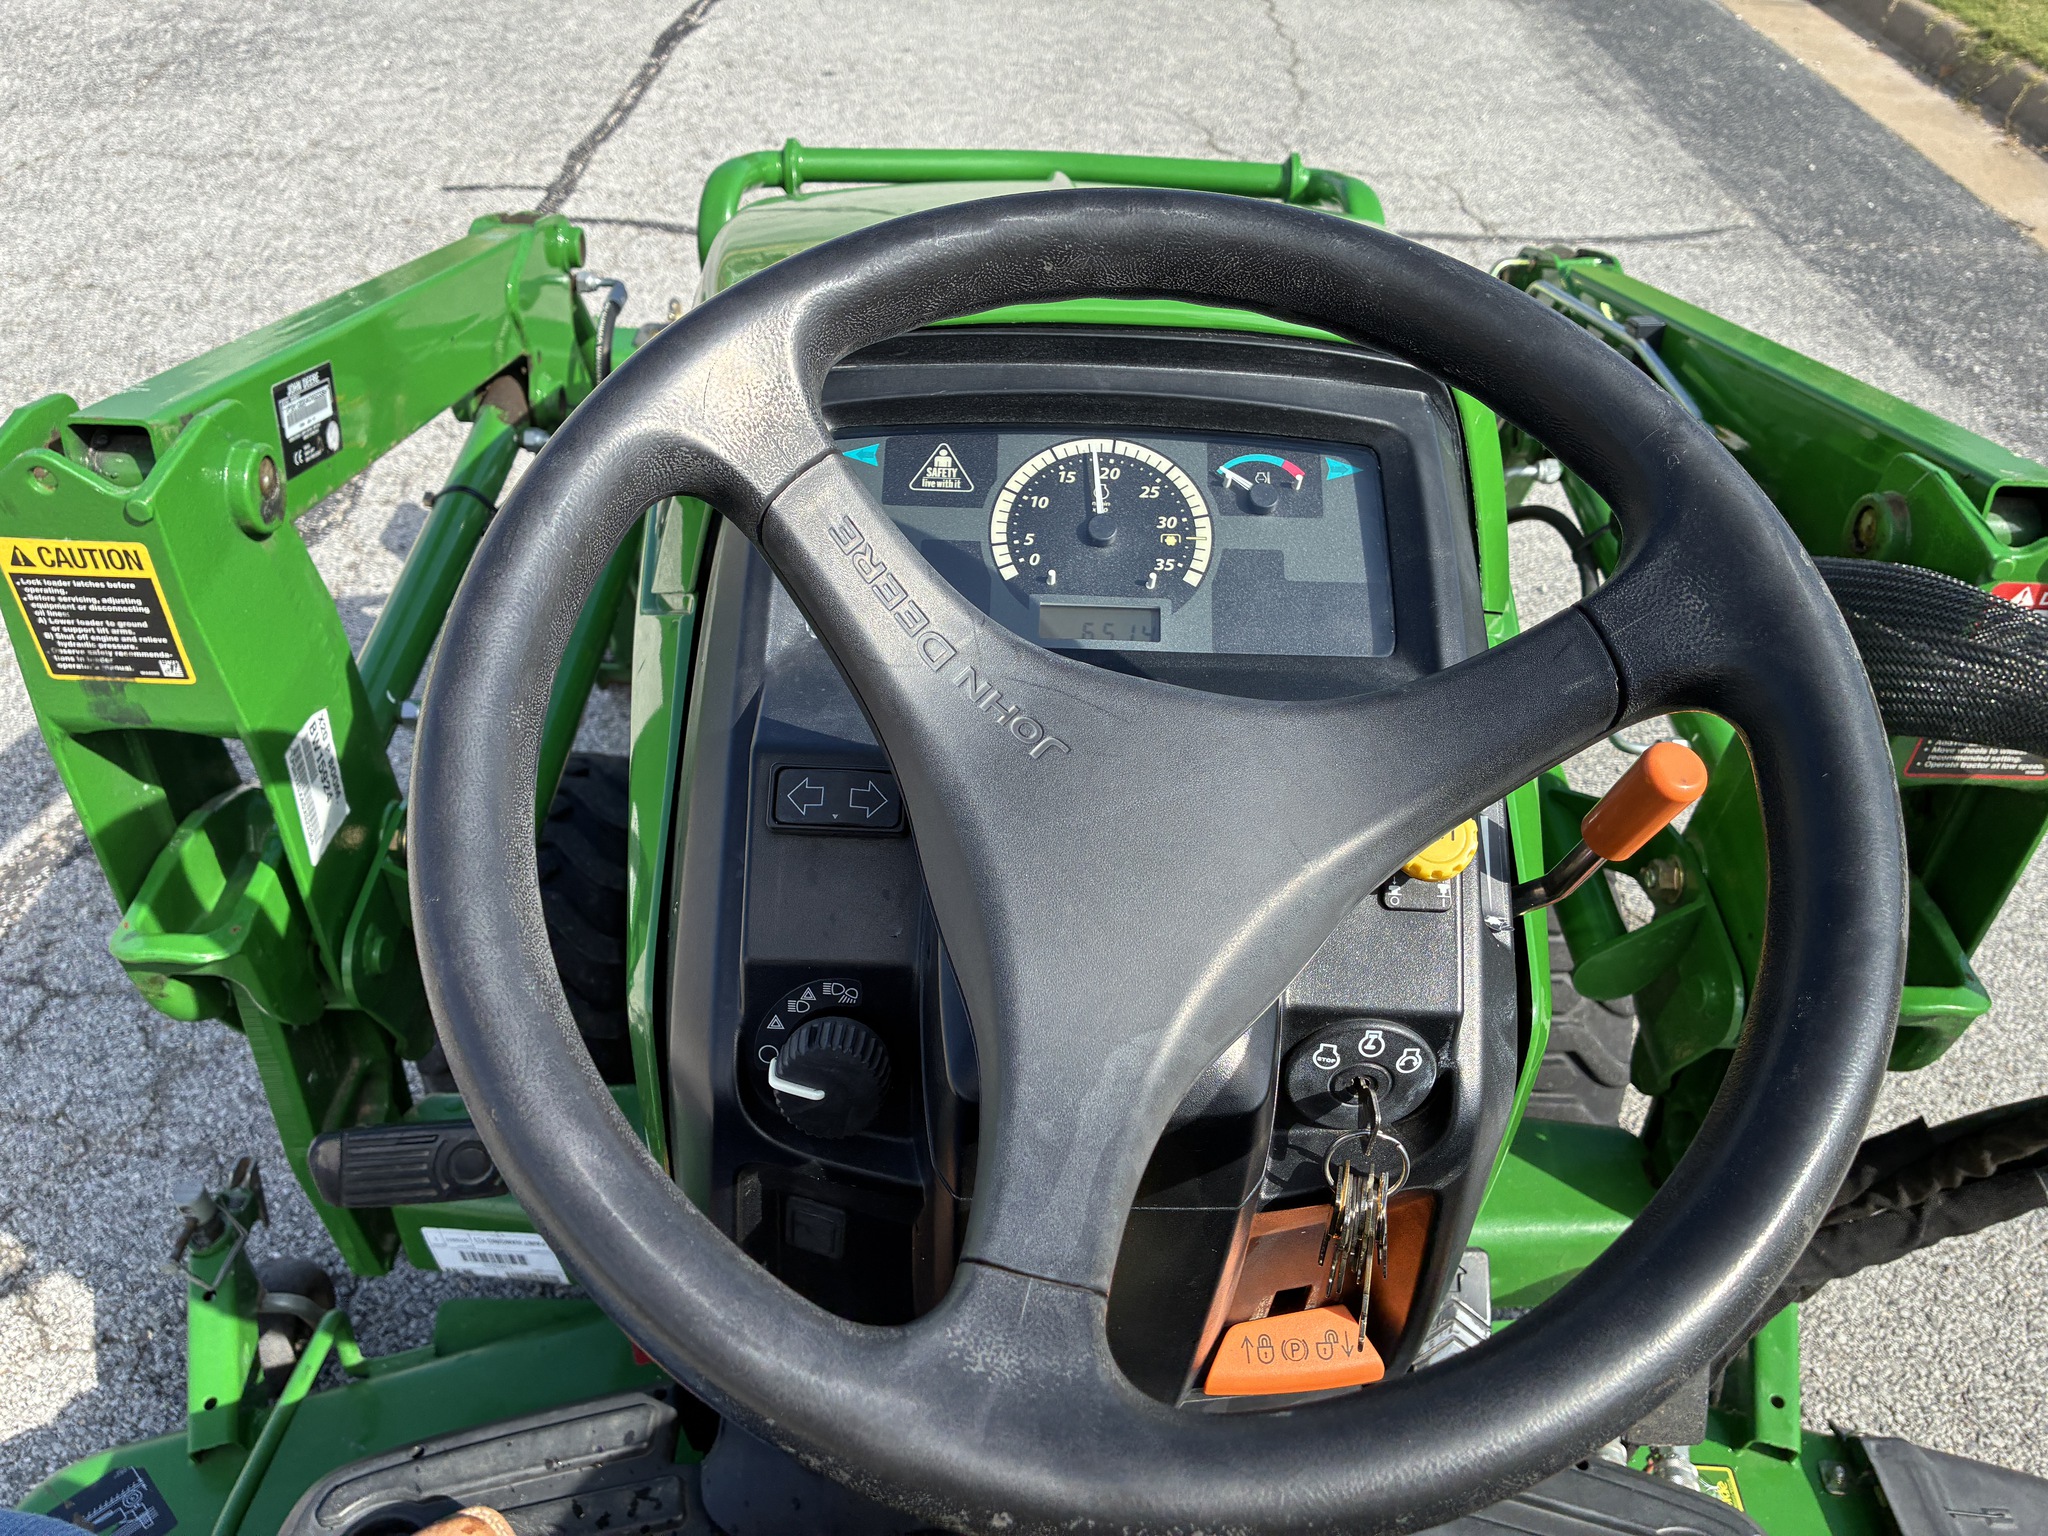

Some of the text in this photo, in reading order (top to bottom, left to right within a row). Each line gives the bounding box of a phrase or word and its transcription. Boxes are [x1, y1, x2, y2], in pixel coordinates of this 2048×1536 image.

[926, 466, 958, 478] SAFETY
[1058, 471, 1076, 484] 15
[1099, 467, 1121, 480] 20
[922, 478, 962, 488] live with it
[1138, 486, 1160, 499] 25
[1030, 496, 1049, 508] 10
[1156, 516, 1178, 528] 30
[1023, 533, 1035, 546] 5
[36, 546, 144, 570] CAUTION
[1029, 553, 1040, 566] 0
[1154, 558, 1176, 571] 35
[828, 515, 1072, 760] JOHN DEERE
